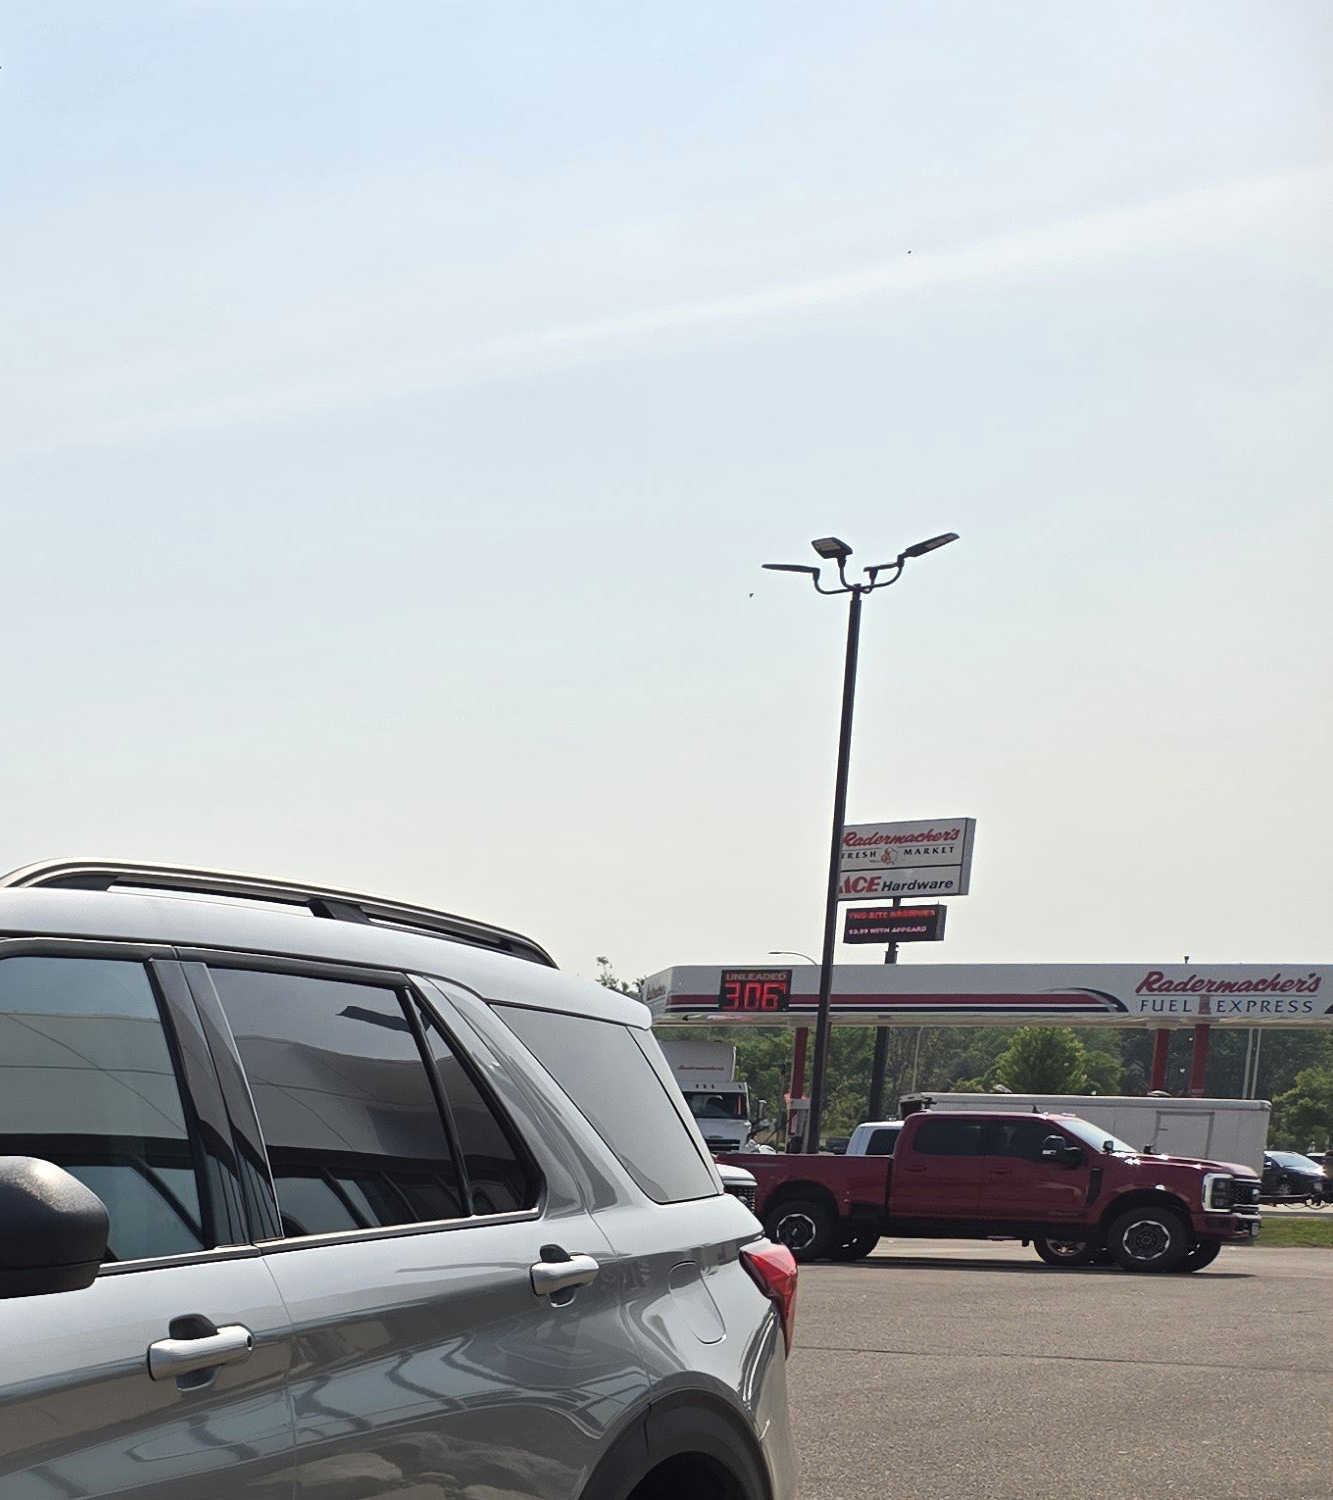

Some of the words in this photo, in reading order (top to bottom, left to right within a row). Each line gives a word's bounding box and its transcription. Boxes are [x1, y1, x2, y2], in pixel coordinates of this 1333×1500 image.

[842, 828, 961, 847] Radermacher's
[903, 846, 955, 856] MARKET
[838, 876, 882, 894] ACE
[881, 880, 954, 892] Hardware
[726, 971, 787, 981] UNLEADED
[1135, 971, 1322, 994] Radermacher's
[1140, 1000, 1192, 1012] FUEL
[1216, 1000, 1314, 1014] EXPRESS
